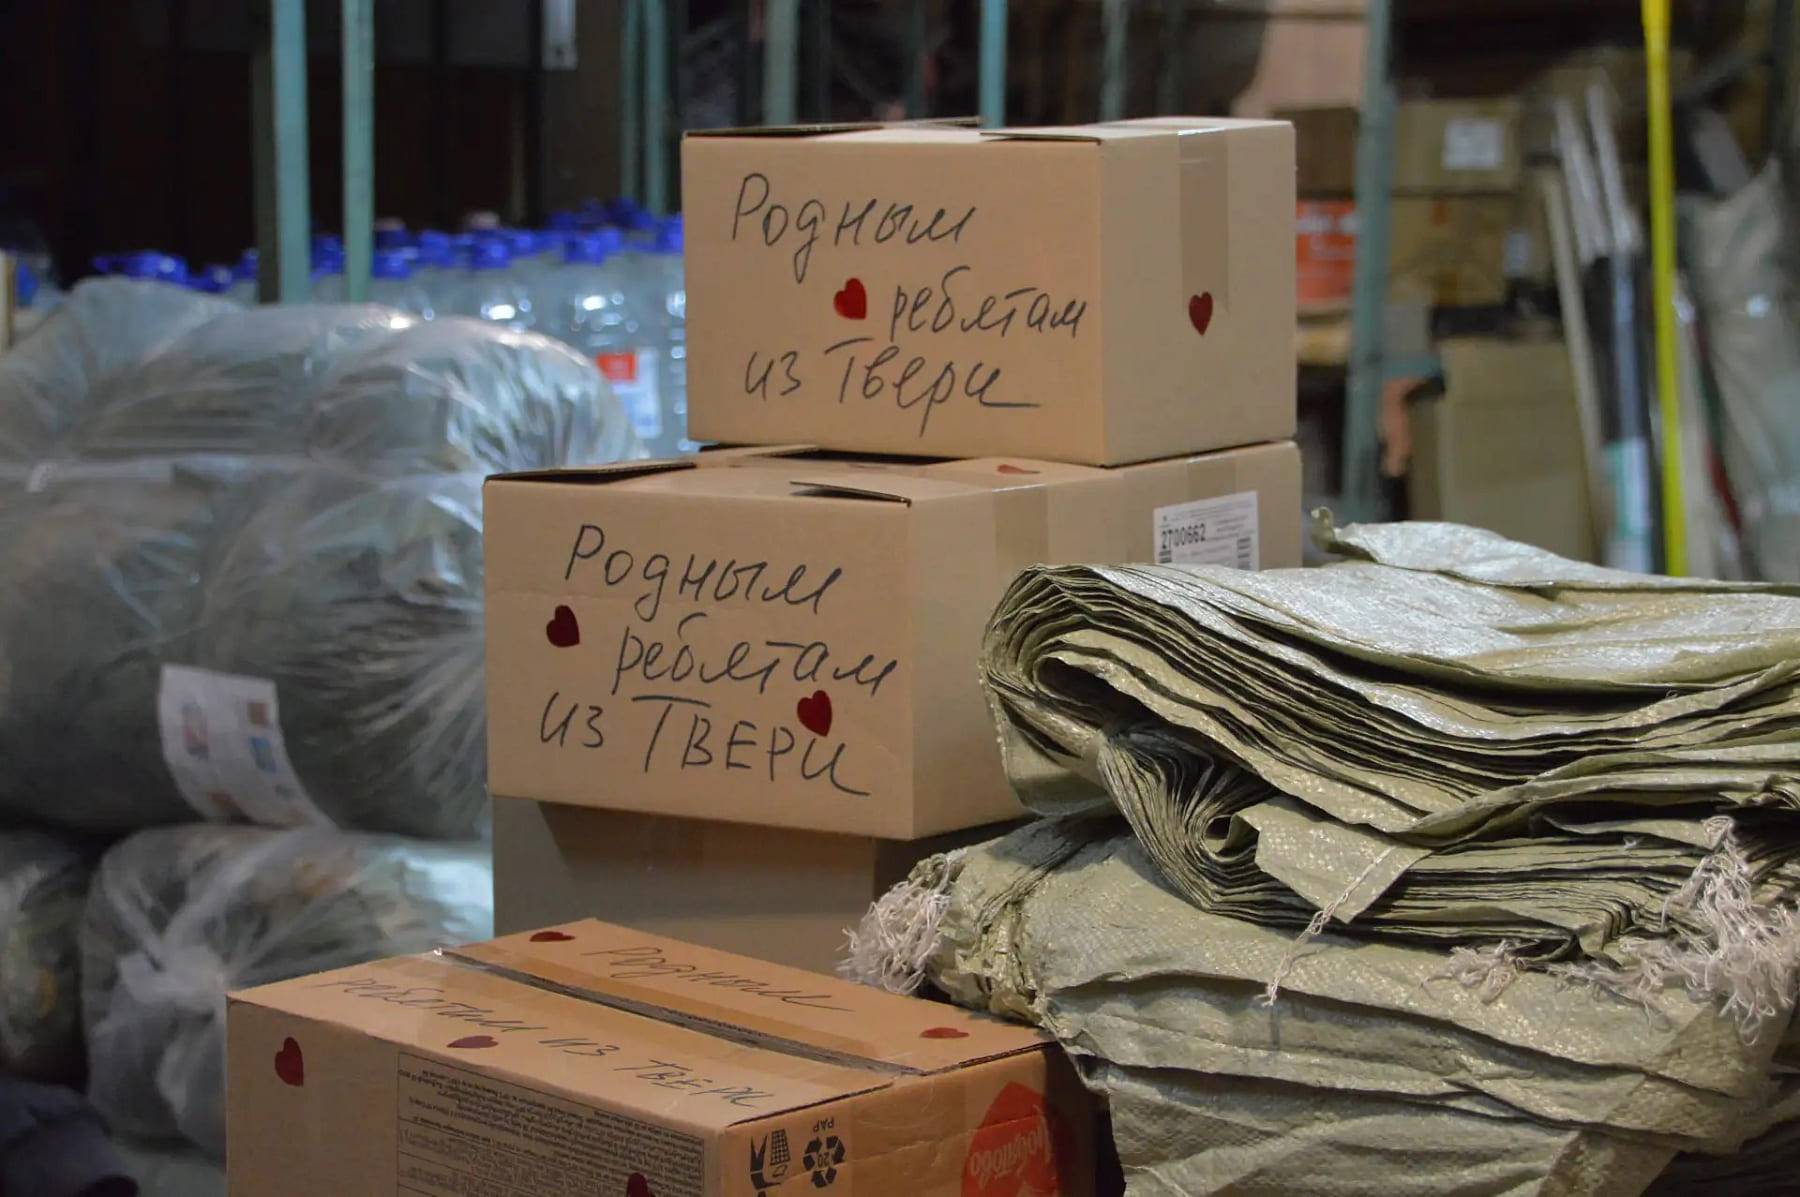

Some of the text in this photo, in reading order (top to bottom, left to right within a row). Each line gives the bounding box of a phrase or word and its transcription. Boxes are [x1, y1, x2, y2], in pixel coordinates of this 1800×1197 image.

[732, 172, 977, 283] Родным
[888, 264, 1087, 339] ребятам
[744, 336, 1042, 438] из Твери
[565, 523, 843, 623] Родным
[611, 612, 899, 697] ребятам
[580, 946, 857, 1013] Родным
[812, 1116, 835, 1133] PAP
[817, 1152, 830, 1168] 20
